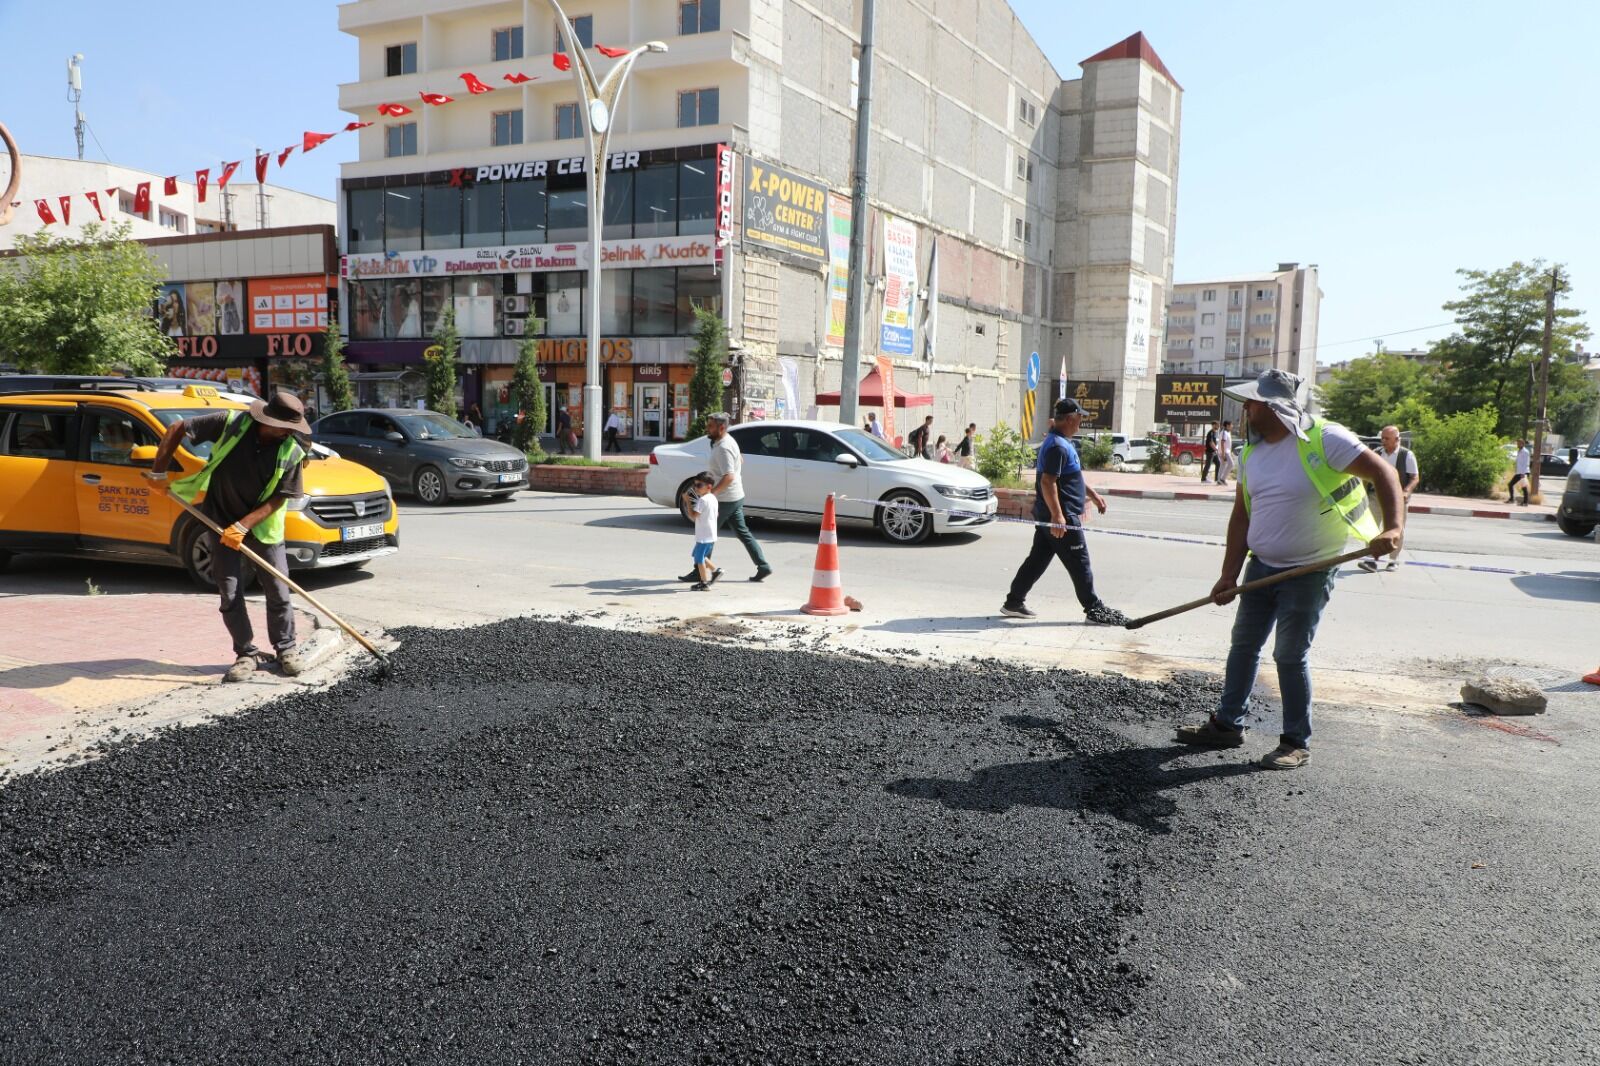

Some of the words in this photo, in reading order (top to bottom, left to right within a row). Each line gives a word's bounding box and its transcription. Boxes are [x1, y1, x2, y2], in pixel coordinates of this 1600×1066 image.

[557, 151, 640, 175] CEER
[721, 149, 732, 228] SPOR
[749, 166, 825, 214] X-POWER
[775, 205, 814, 230] CENTER
[772, 223, 785, 233] GYM
[791, 228, 805, 240] FIGHT
[601, 245, 646, 263] Gelinlik
[445, 261, 497, 273] Epilasyon
[177, 335, 218, 358] FLO
[266, 334, 312, 357] FLO
[1172, 382, 1209, 393] BATI
[1161, 394, 1218, 406] EMLAK
